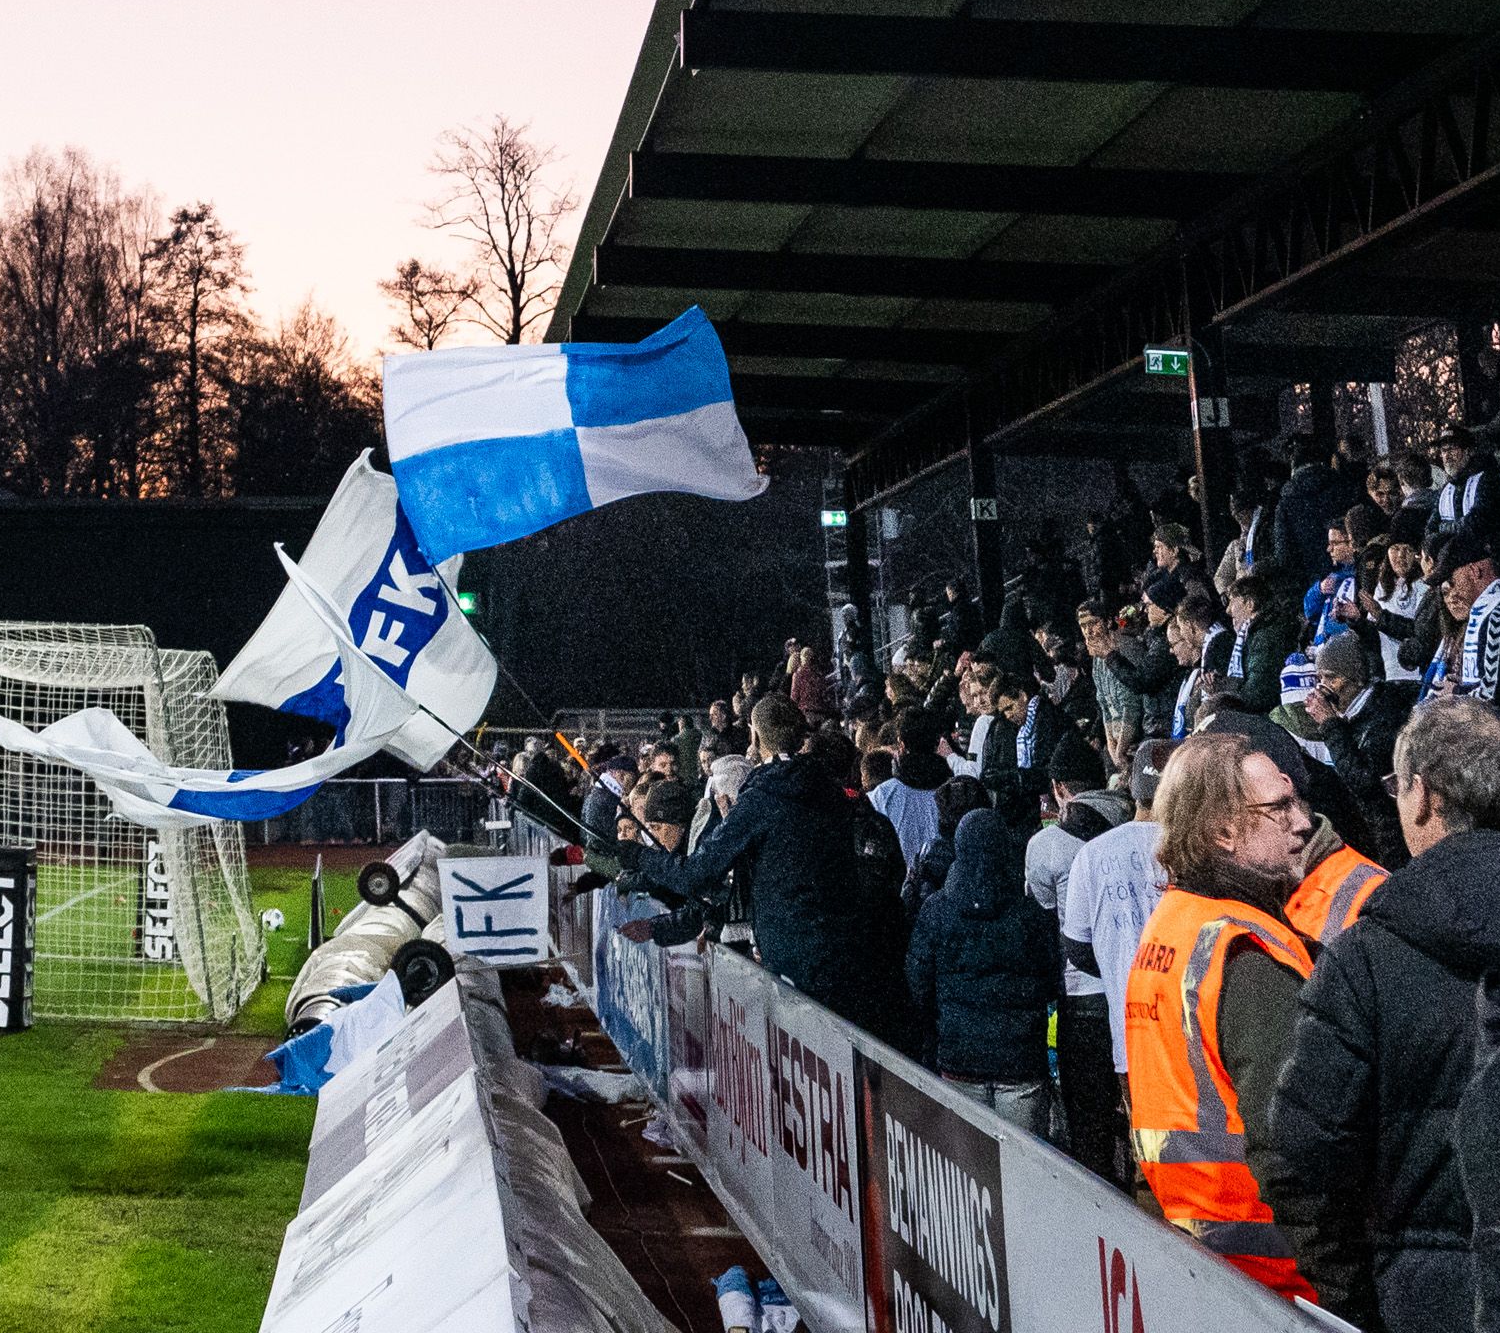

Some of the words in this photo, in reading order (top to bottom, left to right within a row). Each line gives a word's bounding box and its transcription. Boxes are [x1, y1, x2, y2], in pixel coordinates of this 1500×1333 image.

[1206, 397, 1221, 428] J
[979, 500, 995, 517] K
[337, 549, 440, 683] FK
[144, 840, 174, 961] SELECT
[451, 870, 539, 957] IFK
[766, 1015, 855, 1223] HESTRA
[884, 1112, 1001, 1333] BEMANNINGS
